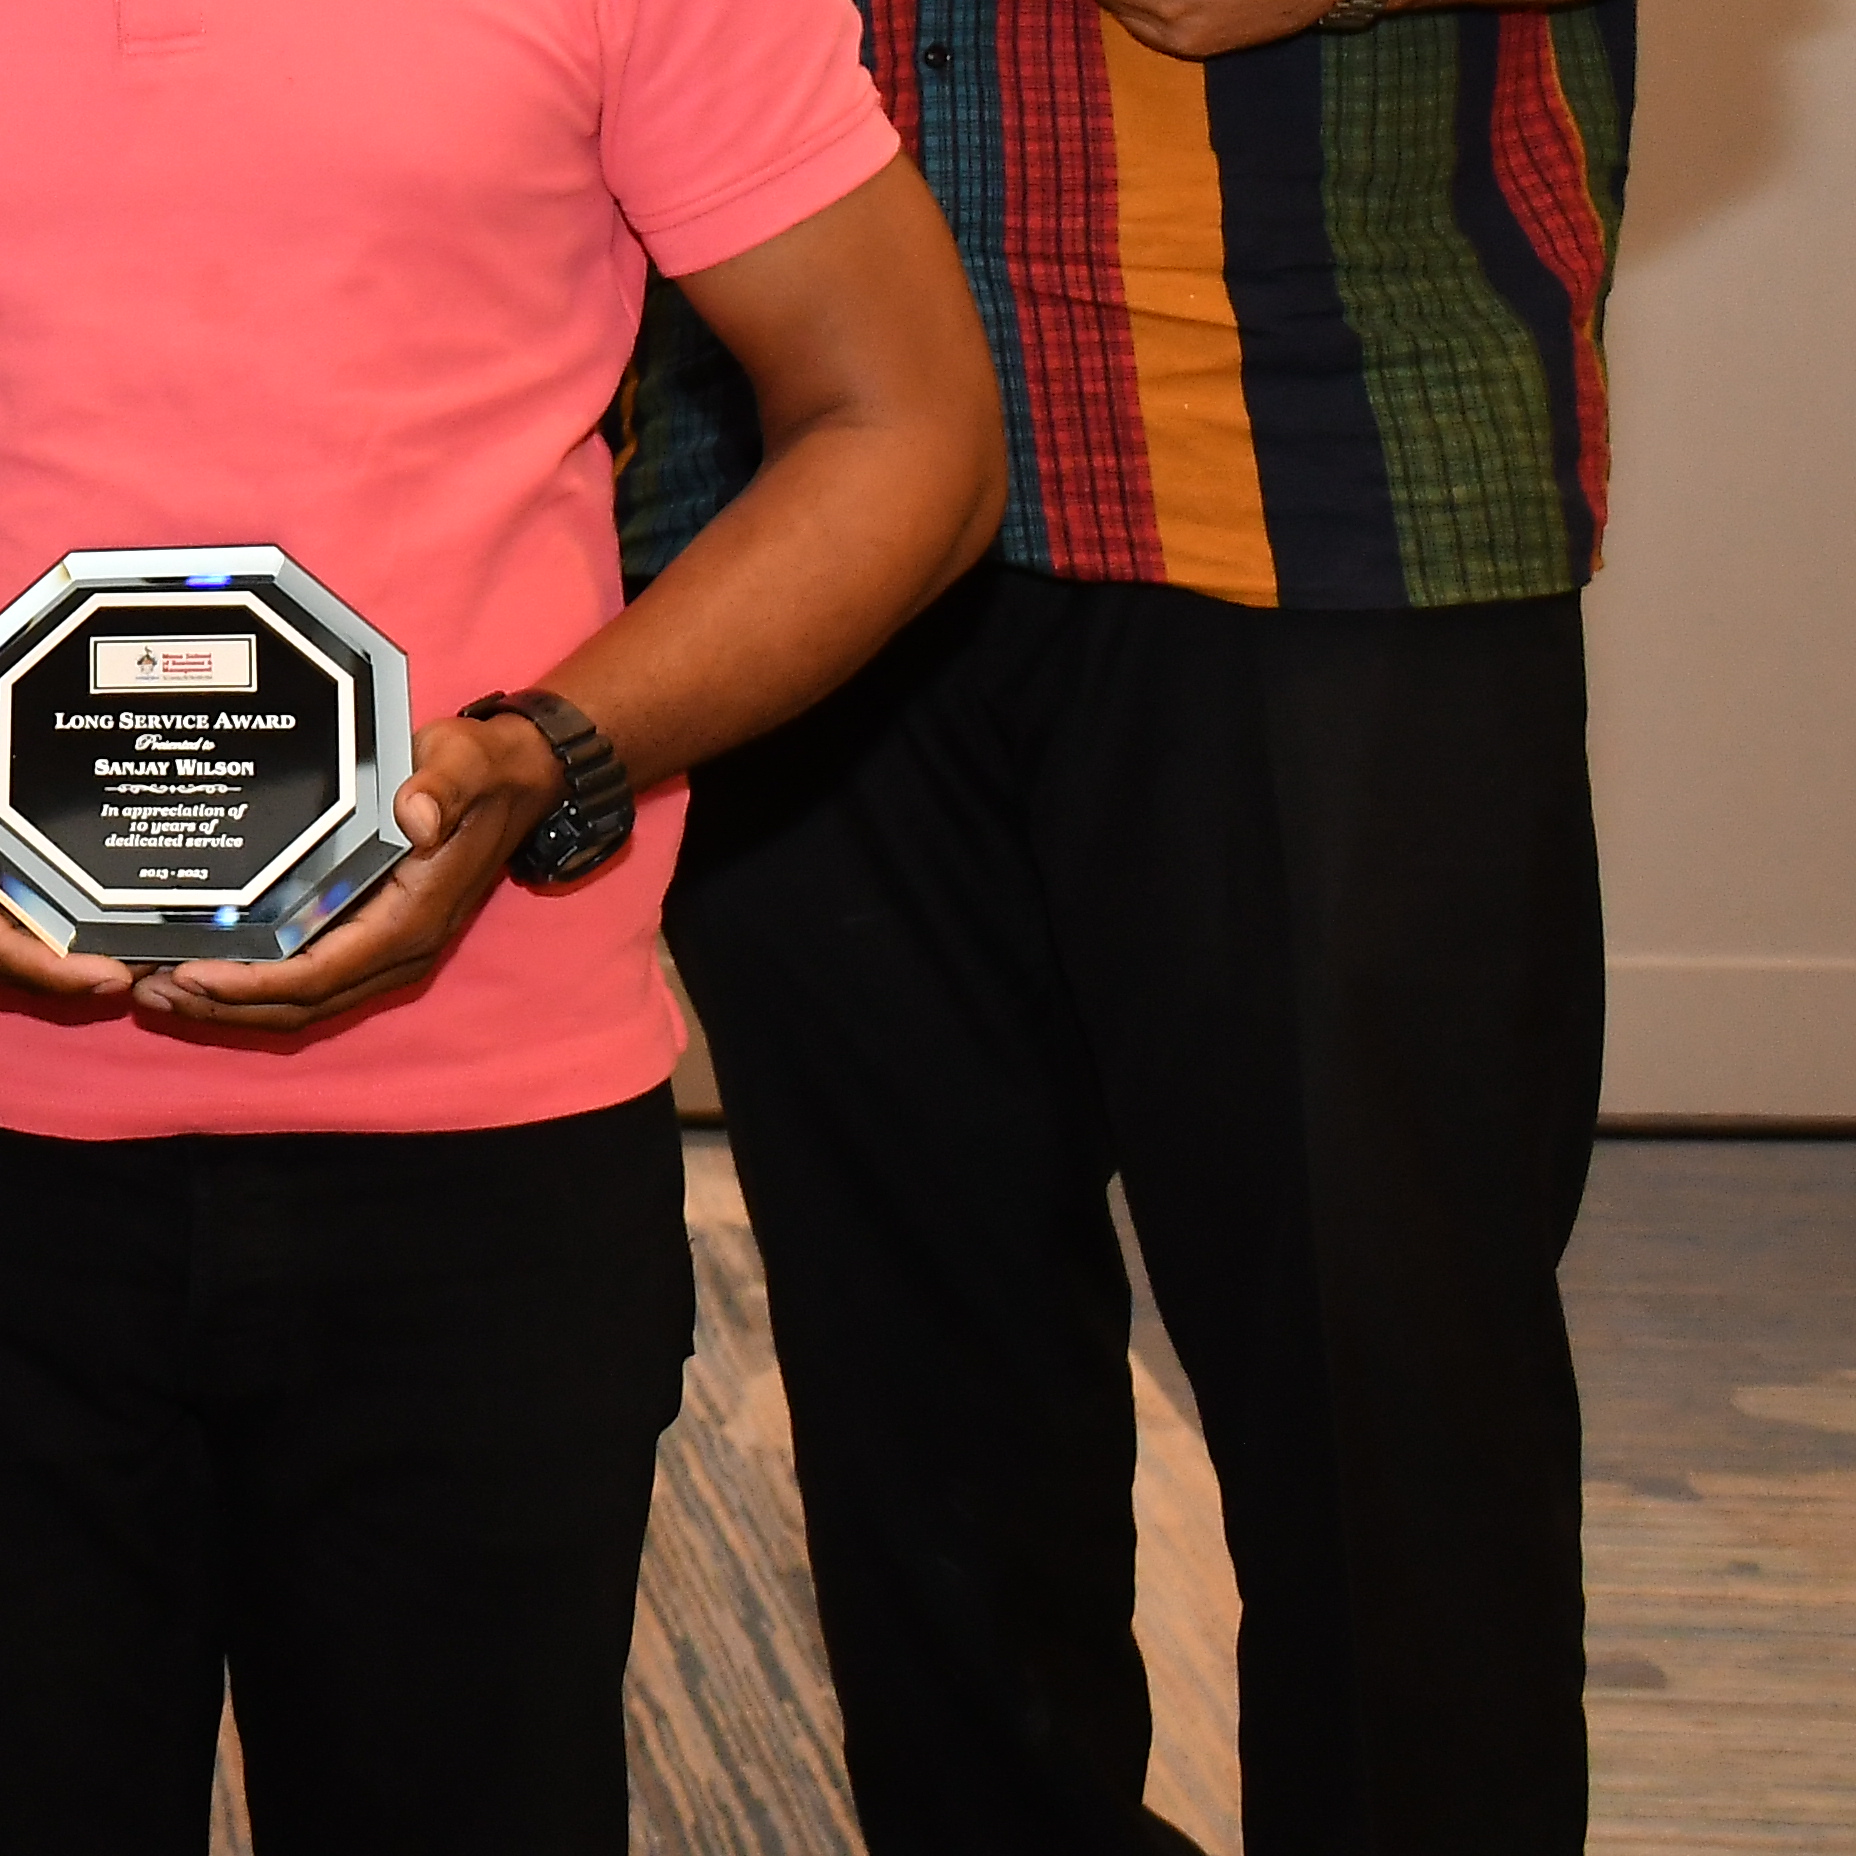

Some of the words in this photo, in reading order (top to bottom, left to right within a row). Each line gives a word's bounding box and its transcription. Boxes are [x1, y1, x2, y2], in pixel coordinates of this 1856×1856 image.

[101, 804, 120, 818] In
[121, 804, 226, 820] appreciation
[227, 804, 248, 820] of
[129, 821, 149, 833] 10
[150, 821, 197, 835] years
[198, 819, 220, 835] of
[104, 834, 184, 848] dedicated
[185, 834, 244, 848] service
